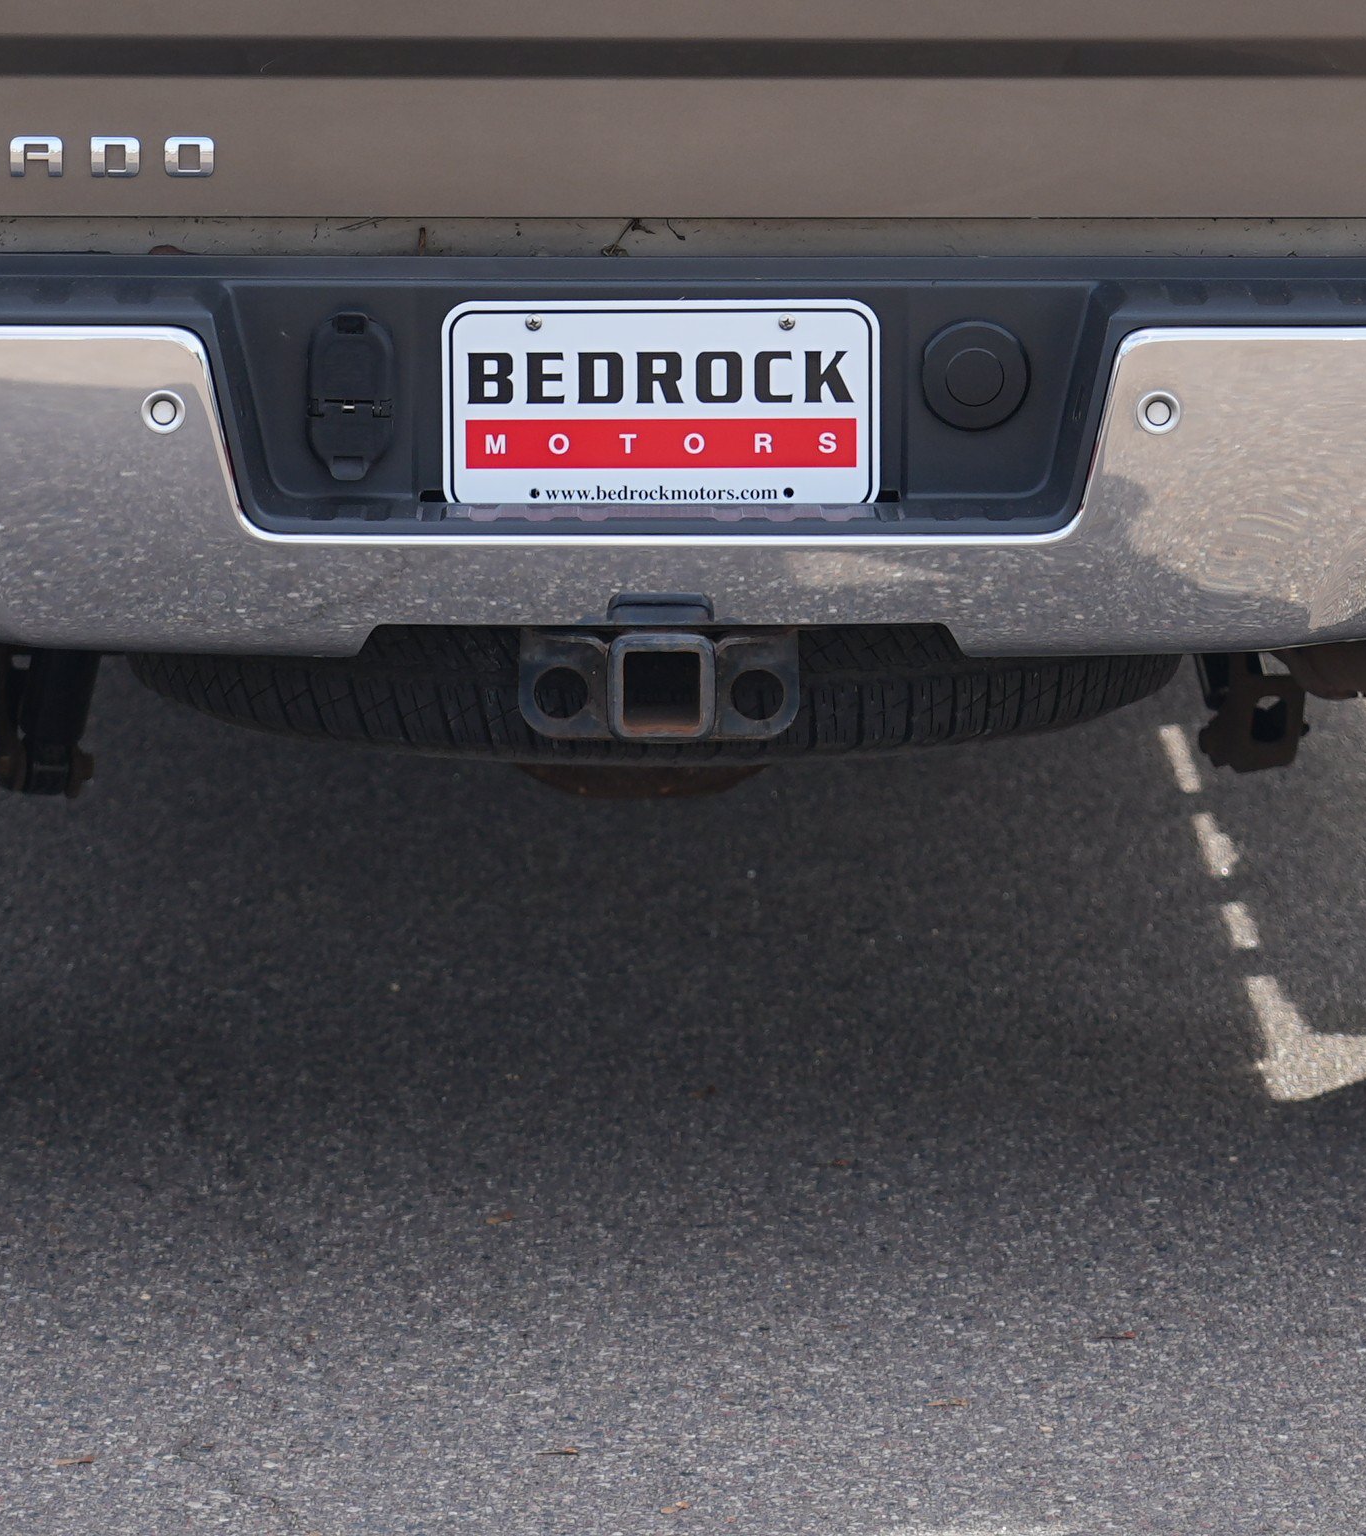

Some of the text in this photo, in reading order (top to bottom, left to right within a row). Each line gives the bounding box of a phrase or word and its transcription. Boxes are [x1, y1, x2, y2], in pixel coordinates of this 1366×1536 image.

[466, 350, 855, 405] BEDROCK
[484, 431, 838, 455] MOTORS
[544, 484, 779, 502] www.bedrockmotors.com
